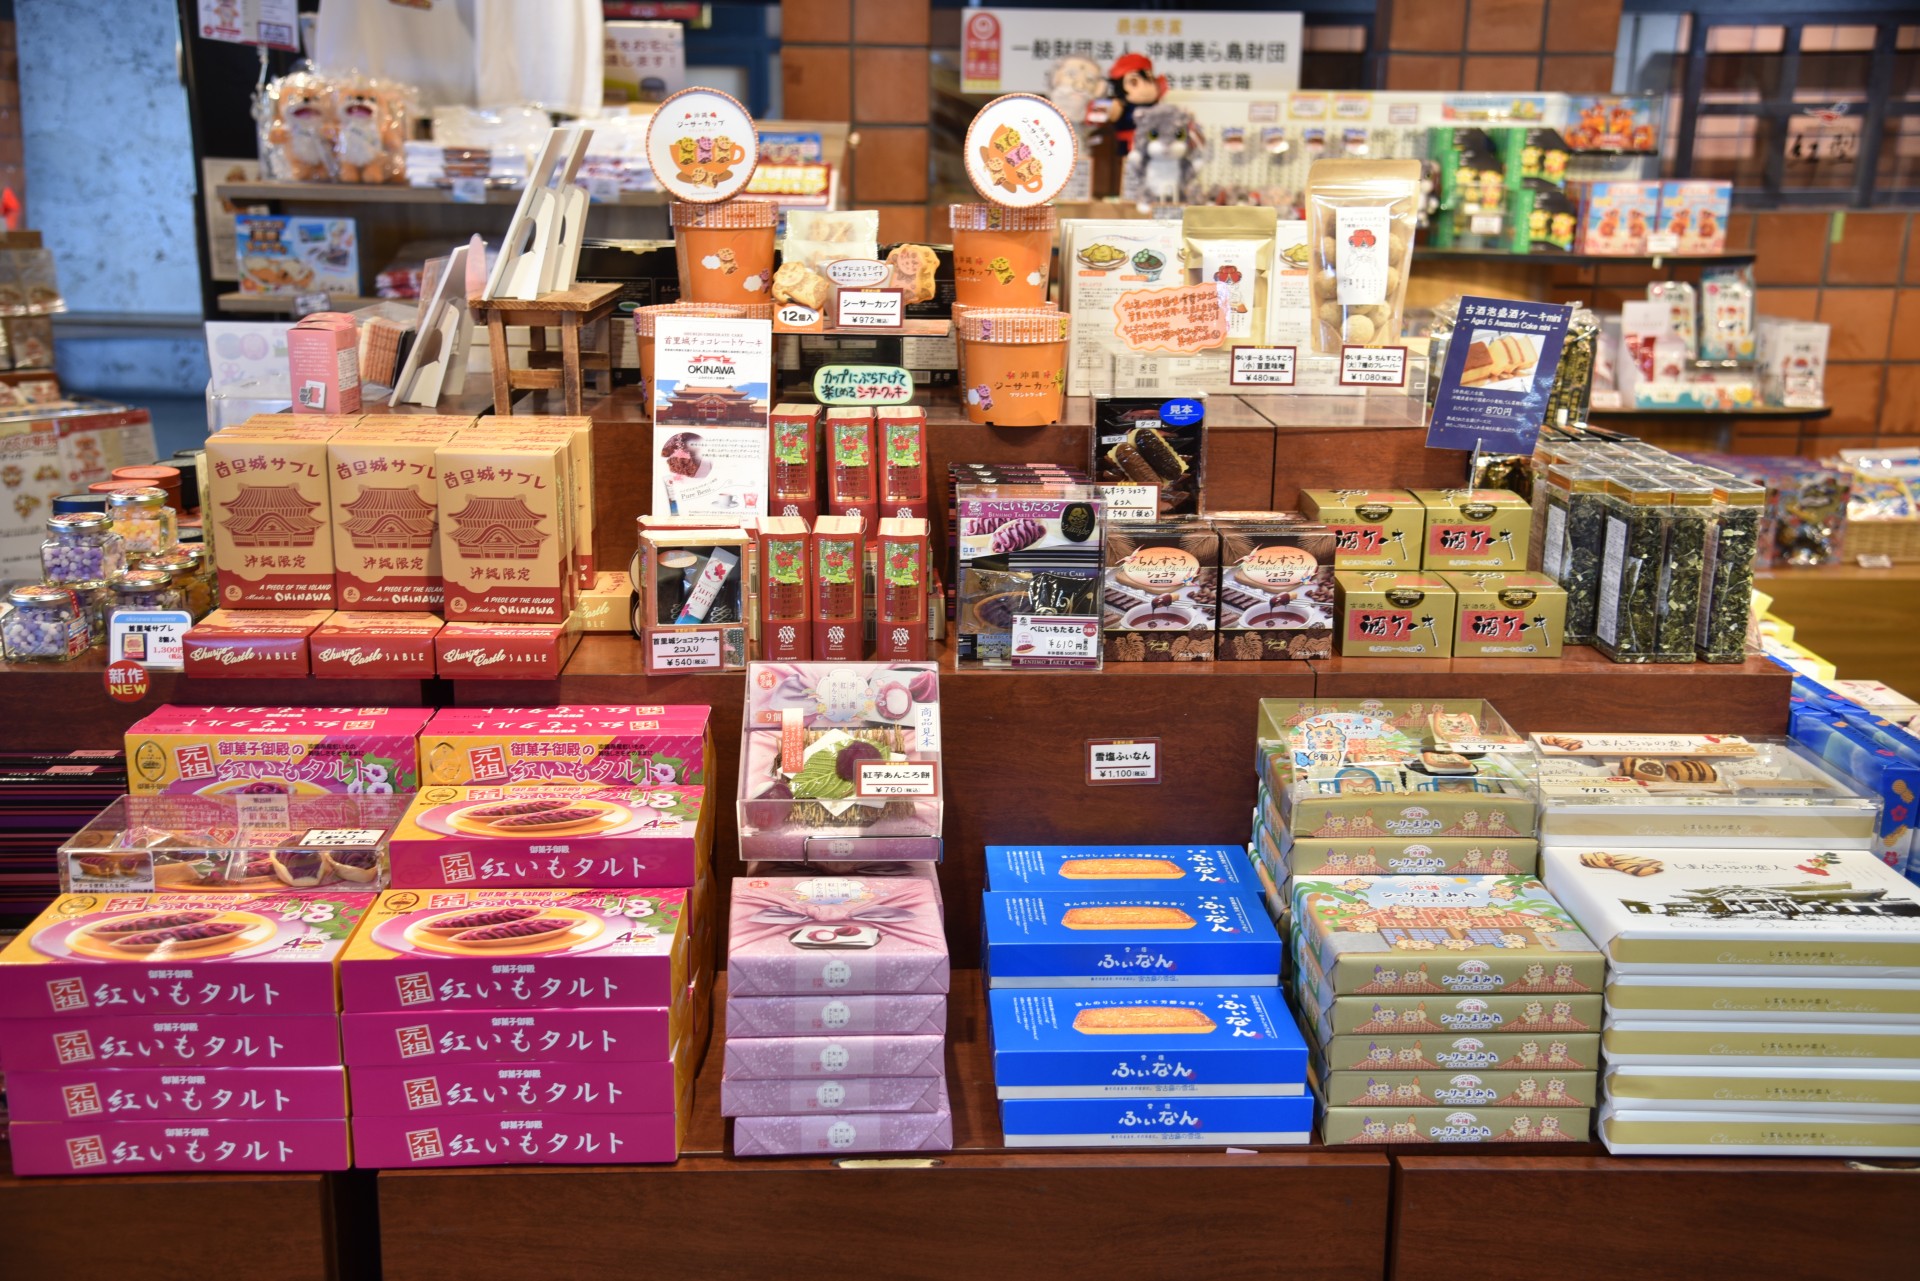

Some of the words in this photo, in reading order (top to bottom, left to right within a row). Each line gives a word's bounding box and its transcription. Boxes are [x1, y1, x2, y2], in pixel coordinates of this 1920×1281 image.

[1012, 40, 1136, 61] 一般財団法人
[1145, 42, 1288, 63] 沖縄美ら島財団
[842, 299, 898, 309] シーサーカップ
[781, 310, 815, 322] 12個入
[1464, 304, 1563, 323] 古酒泡盛酒ケーキmini
[1471, 317, 1487, 326] Aged
[1487, 318, 1493, 326] 5
[1494, 319, 1520, 328] Awamori
[1520, 322, 1538, 331] Cake
[1538, 324, 1552, 332] mini
[663, 335, 764, 348] 首里城チョコレートケーキ
[1235, 354, 1264, 362] ゆいまーる
[1265, 354, 1294, 362] ちんすこう
[1344, 353, 1373, 362] ゆいまーる
[1374, 353, 1403, 362] ちんすこう
[687, 364, 736, 375] OKINAWA
[1256, 362, 1286, 370] 首里味噌
[822, 368, 907, 387] カップにぶら下げて
[1169, 404, 1194, 415] 見本
[1485, 406, 1513, 417] 870円
[214, 454, 320, 479] 首里城サブレ
[443, 467, 547, 490] 首里城サブレ
[987, 501, 1060, 512] べにいもたると
[244, 554, 307, 569] 沖縄限定
[362, 555, 424, 571] 沖縄限定
[1138, 555, 1187, 567] ちんすこう
[1257, 554, 1305, 566] ちんすこう
[469, 565, 531, 581] 沖縄限定
[1147, 571, 1177, 579] ショコラ
[1265, 570, 1294, 578] ショコラ
[274, 592, 332, 602] OKINAWA
[498, 605, 555, 615] OKINAWA
[128, 624, 174, 632] 首里城サブレ
[1029, 625, 1082, 634] べにいもたると
[1359, 612, 1439, 648] 酒ケーキ
[1471, 612, 1550, 648] 酒ケーキ
[653, 637, 720, 646] 首里城ショコラケーキ
[673, 645, 699, 654] 2コ入り
[258, 651, 298, 661] SABLE
[385, 652, 424, 661] SABLE
[509, 653, 548, 663] SABLE
[108, 668, 144, 684] 新作
[109, 684, 147, 695] NEW
[920, 706, 935, 748] 商品見本
[217, 740, 305, 757] 御菓子御殿の
[511, 741, 595, 757] 御菓子御殿の
[473, 746, 505, 779] 元祖
[1095, 751, 1151, 762] 雪塩ふぃなん
[1313, 752, 1338, 762] 8個入
[178, 746, 214, 780] 元祖
[862, 771, 931, 779] 紅芋あんころ餅
[1672, 862, 1788, 872] しまんちゅの恋人
[1097, 953, 1175, 970] ふぃなん
[491, 1016, 535, 1026] 御菓子御殿
[99, 1034, 284, 1059] 紅いもタルト
[439, 1028, 617, 1054] 紅いもタルト
[498, 1069, 541, 1079] 御菓子御殿
[1111, 1061, 1193, 1078] ふぃなん
[161, 1075, 206, 1085] 御菓子御殿
[408, 1079, 439, 1107] 元祖
[446, 1080, 623, 1105] 紅いもタルト
[107, 1087, 290, 1112] 紅いもタルト
[1118, 1110, 1199, 1127] ふぃなん
[500, 1120, 543, 1130] 御菓子御殿
[164, 1127, 210, 1137] 御菓子御殿
[410, 1130, 441, 1158] 元祖
[448, 1131, 624, 1157] 紅いもタルト
[71, 1137, 105, 1167] 元祖
[111, 1139, 294, 1164] 紅いもタルト
